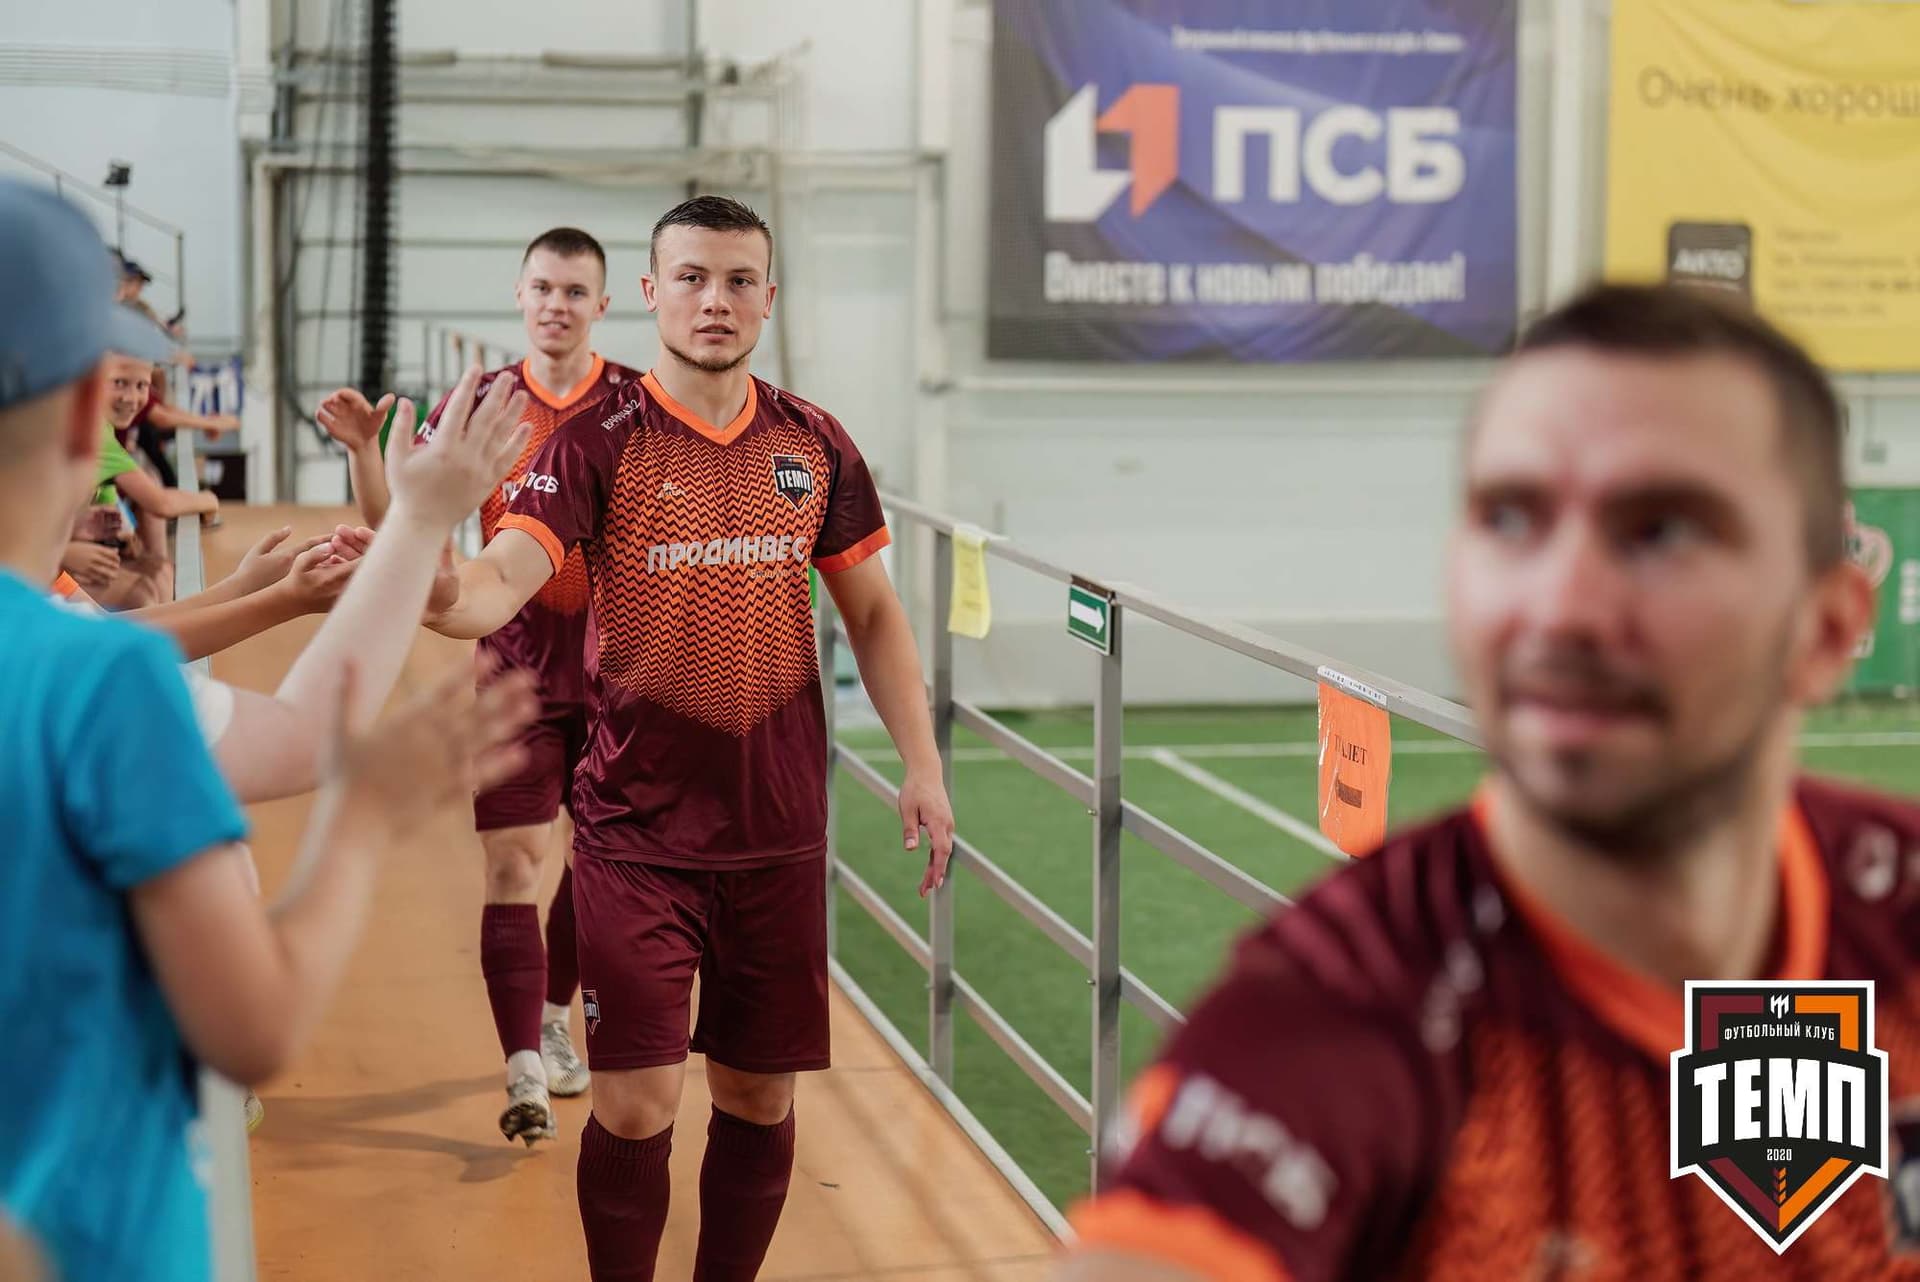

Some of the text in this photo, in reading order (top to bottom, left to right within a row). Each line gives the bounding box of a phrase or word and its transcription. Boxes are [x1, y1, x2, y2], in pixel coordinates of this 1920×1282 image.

[1212, 104, 1467, 205] ПСБ
[1044, 252, 1166, 302] Вместе
[1196, 263, 1312, 303] новым
[777, 470, 811, 491] ТЕМП
